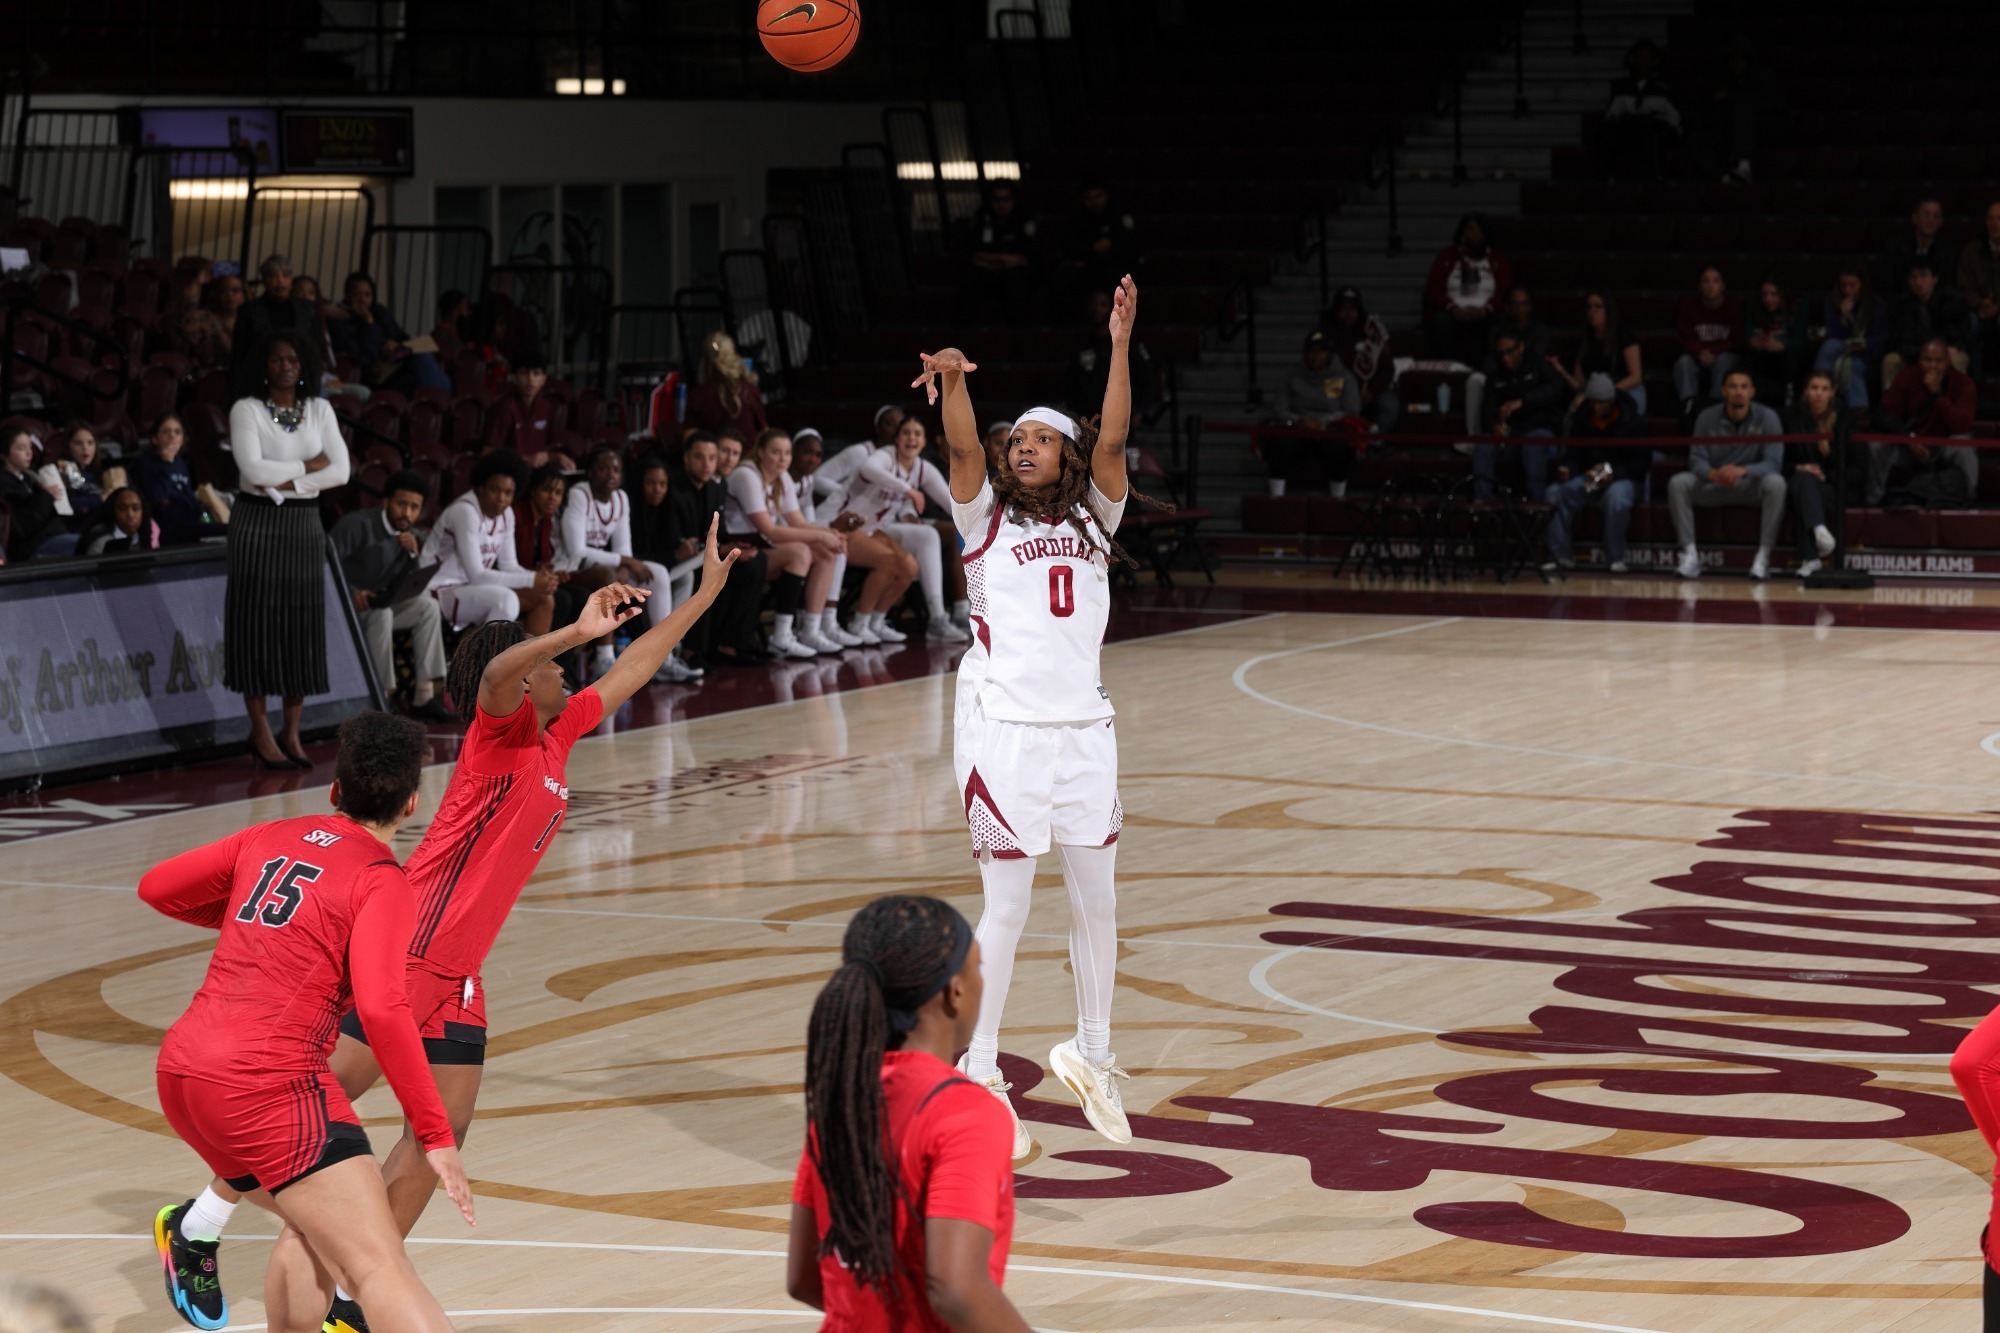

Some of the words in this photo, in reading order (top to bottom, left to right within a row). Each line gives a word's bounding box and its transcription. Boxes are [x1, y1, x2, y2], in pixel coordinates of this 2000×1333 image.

[319, 116, 376, 141] ENZO'S
[1843, 554, 1922, 571] FORDHAM
[1925, 556, 1975, 572] RAMS
[1049, 565, 1075, 617] 0
[32, 637, 154, 714] Arthur
[302, 829, 343, 847] SFU
[532, 810, 563, 852] 1
[235, 855, 325, 928] 15
[953, 807, 2000, 1258] Fordham
